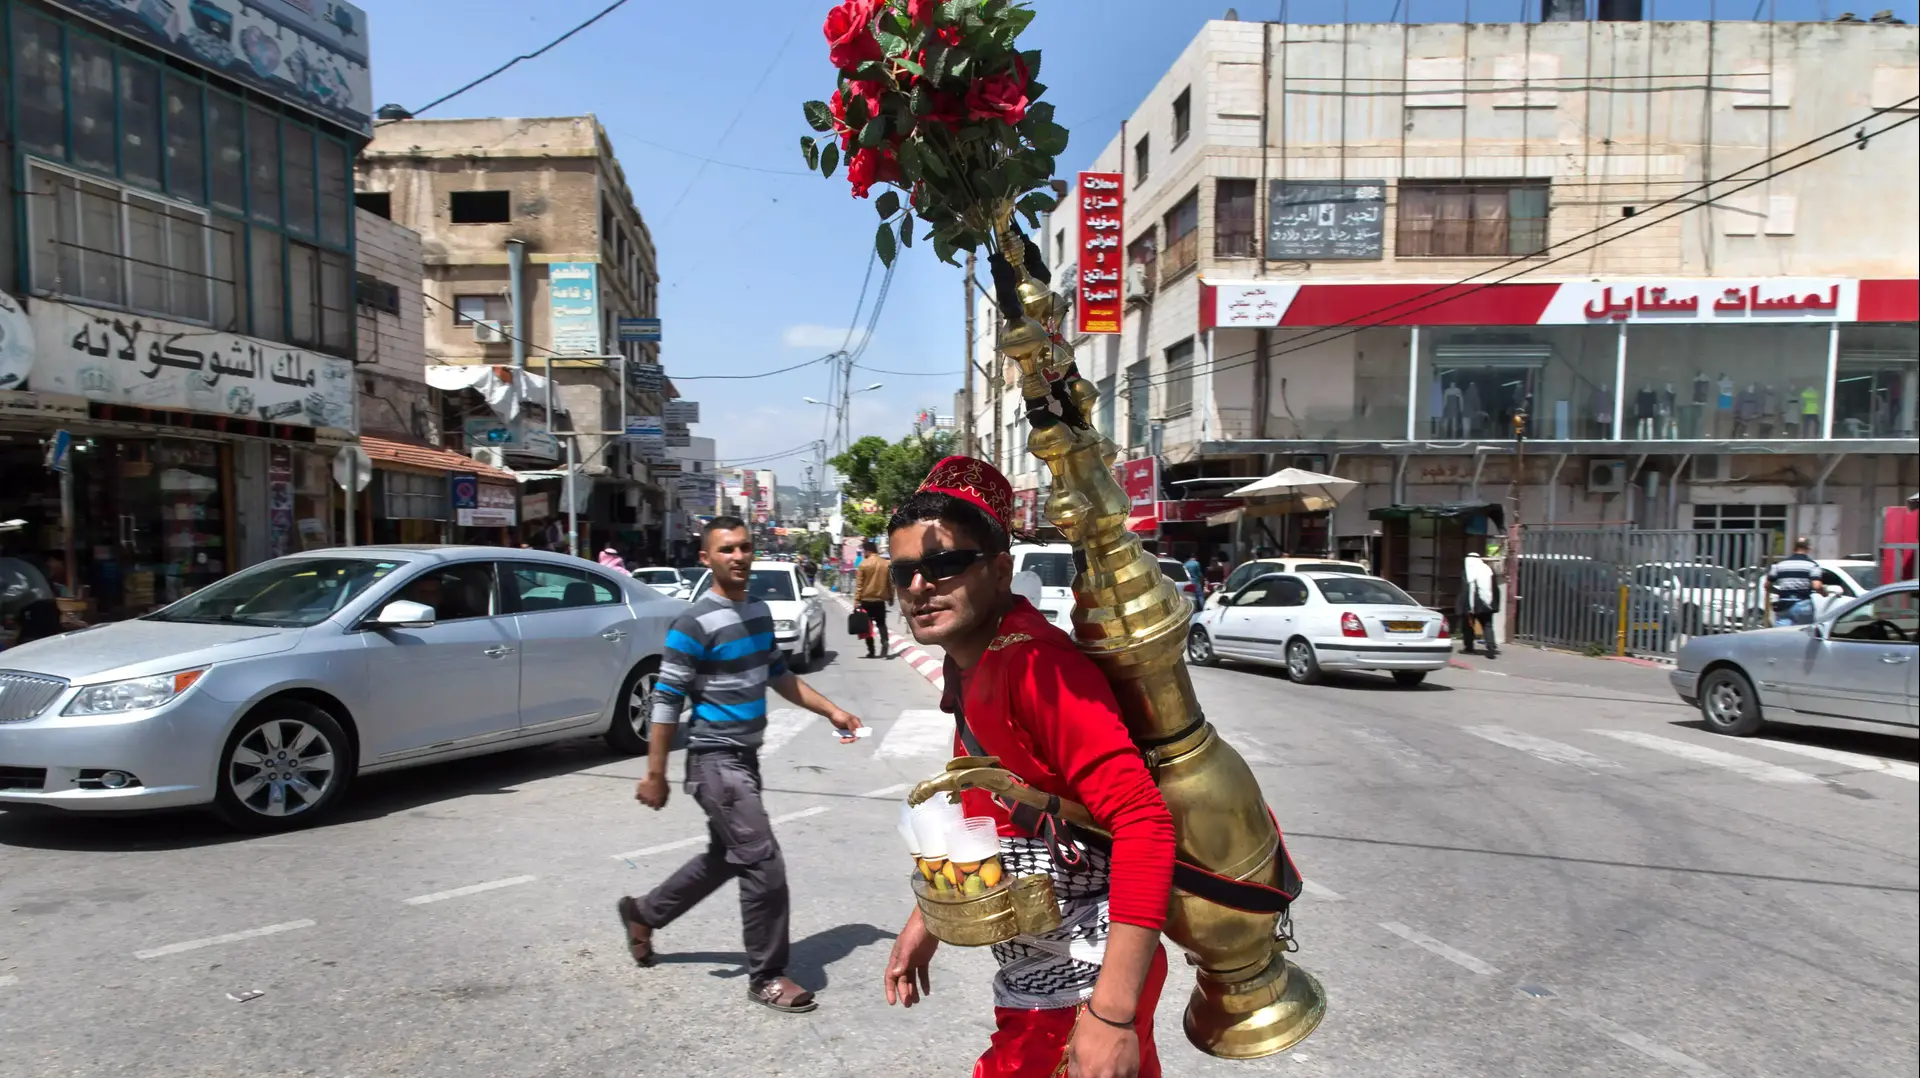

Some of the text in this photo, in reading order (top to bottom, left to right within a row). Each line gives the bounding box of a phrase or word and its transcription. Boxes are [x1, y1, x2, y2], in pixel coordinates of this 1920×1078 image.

[1083, 177, 1119, 191] محلات
[1096, 252, 1104, 263] و
[550, 265, 592, 283] مطعم
[1083, 268, 1118, 284] فساتين
[552, 286, 580, 299] قاعة
[1583, 285, 1839, 321] لمسات ستايل
[71, 318, 316, 388] ملك الشوكولاته
